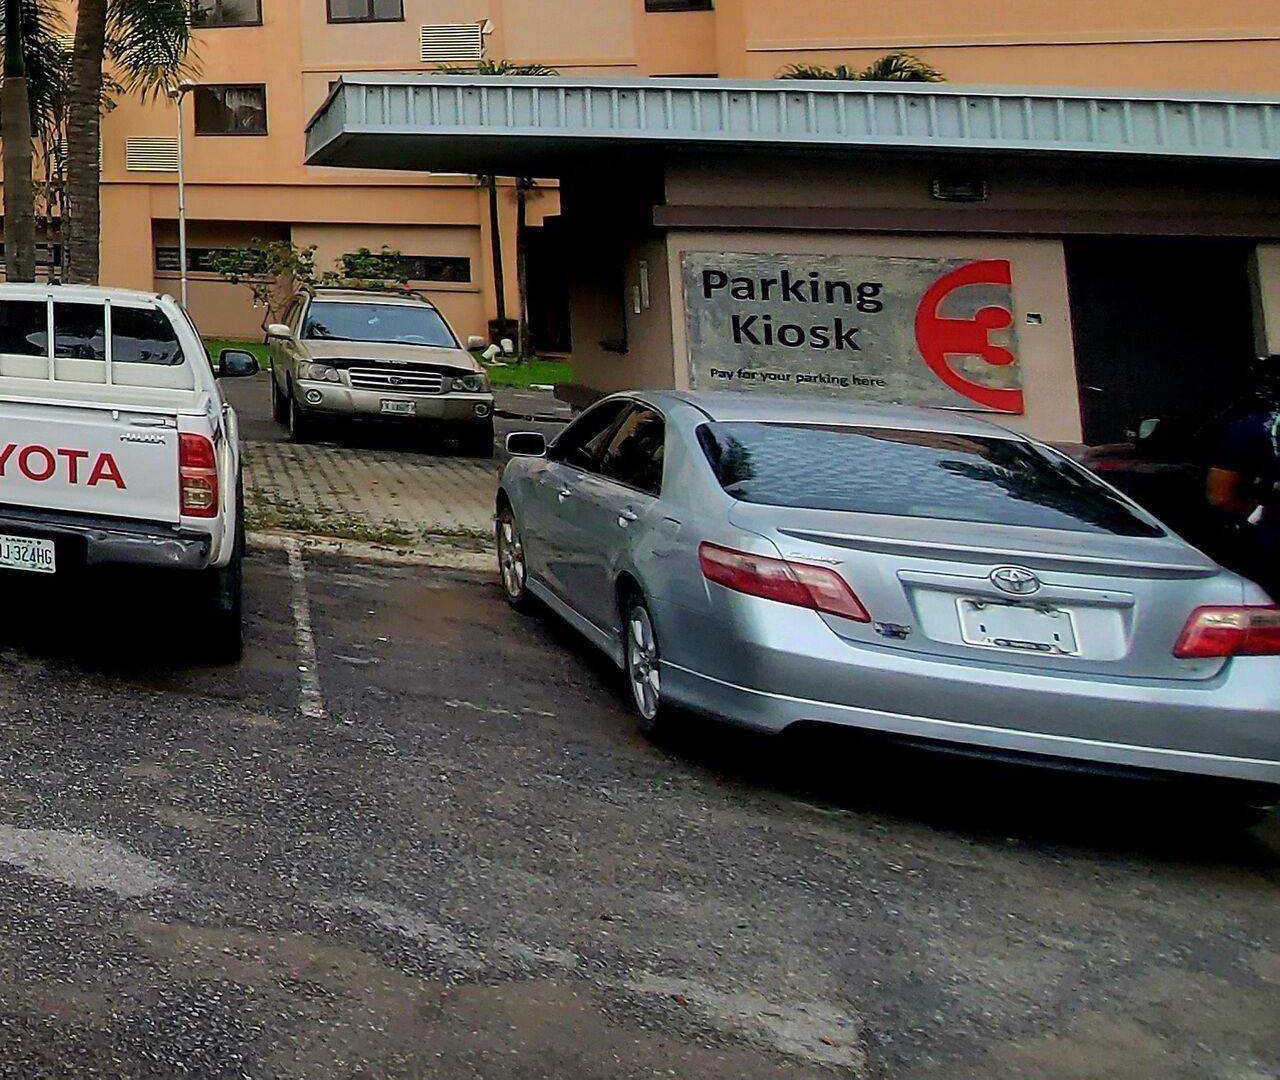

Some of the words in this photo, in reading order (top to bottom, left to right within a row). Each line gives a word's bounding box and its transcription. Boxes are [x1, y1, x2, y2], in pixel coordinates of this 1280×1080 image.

[702, 269, 884, 314] Parking
[731, 314, 861, 352] Kiosk
[710, 368, 734, 380] Pay
[737, 368, 757, 379] for
[760, 372, 791, 382] your
[795, 373, 849, 387] parking
